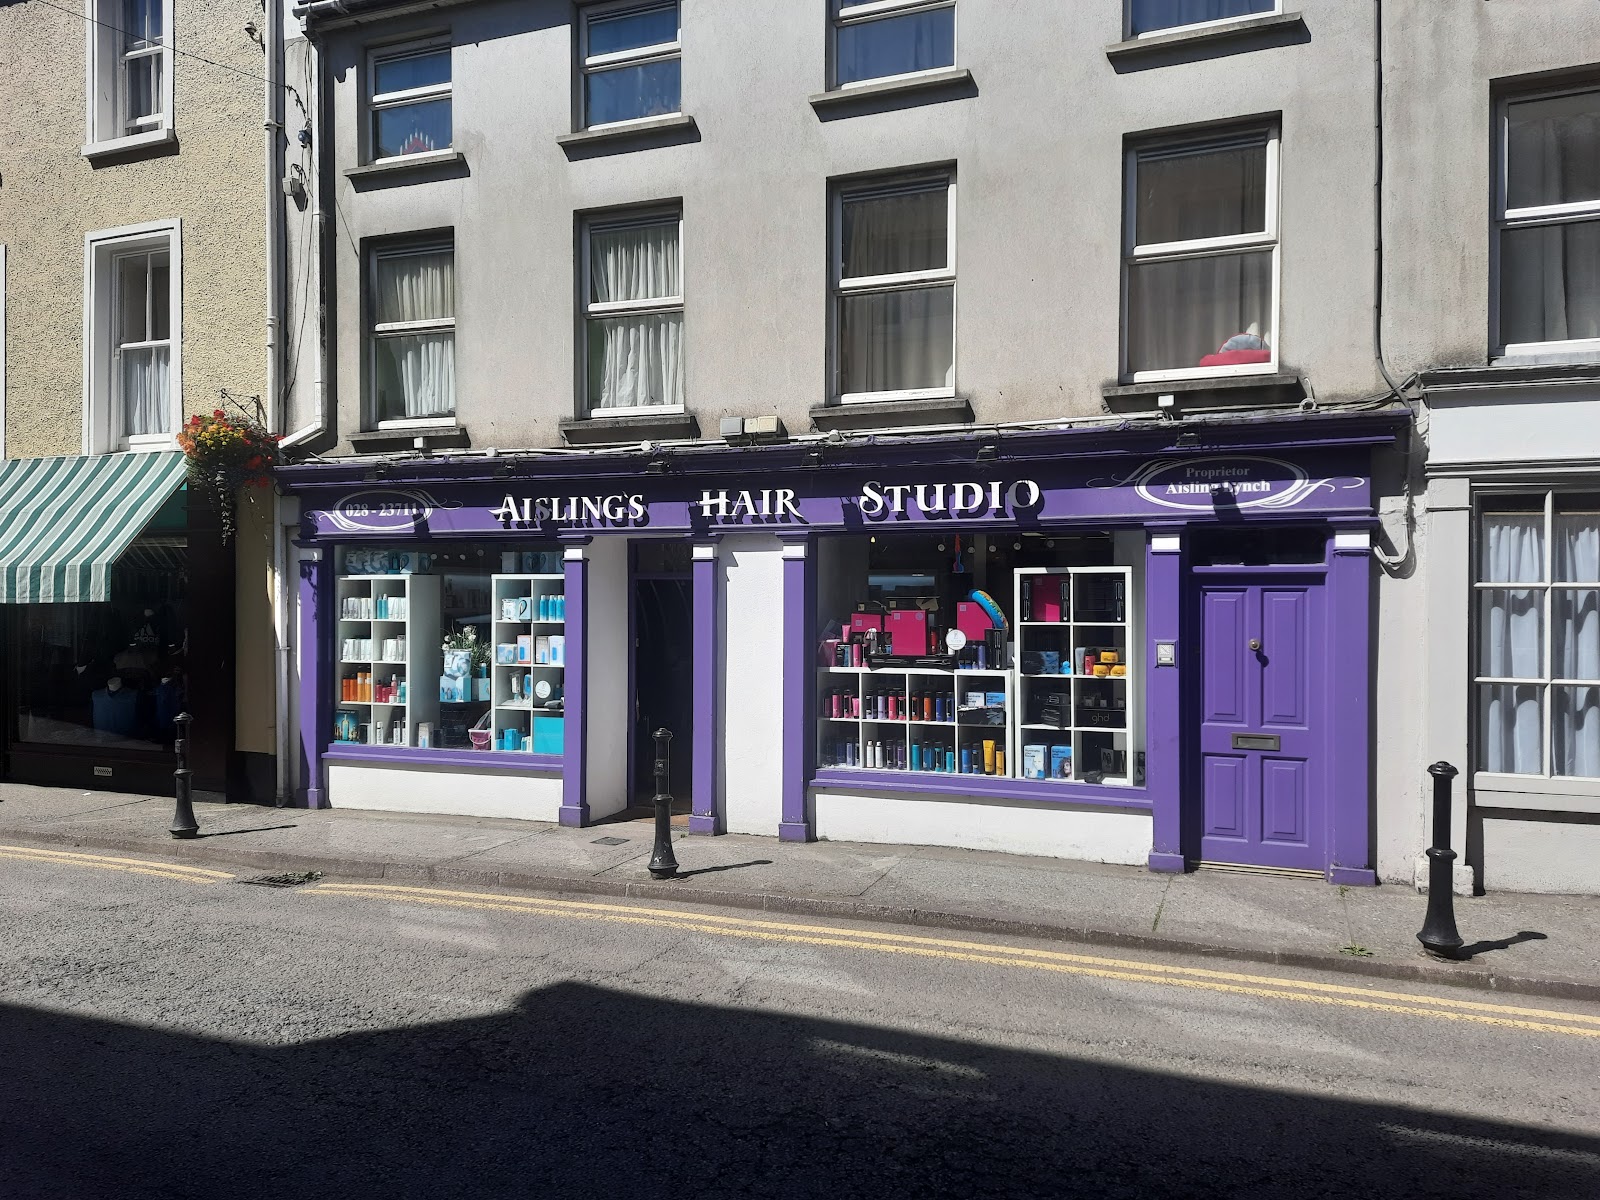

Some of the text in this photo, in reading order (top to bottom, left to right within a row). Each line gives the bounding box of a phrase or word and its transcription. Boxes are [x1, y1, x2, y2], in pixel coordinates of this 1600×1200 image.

[1186, 466, 1250, 479] Proprietor
[1165, 479, 1271, 496] Aisling Lynch
[696, 488, 804, 517] HAIR
[859, 479, 1040, 514] STUDIO
[345, 503, 369, 517] 028
[1091, 712, 1110, 725] ghd
